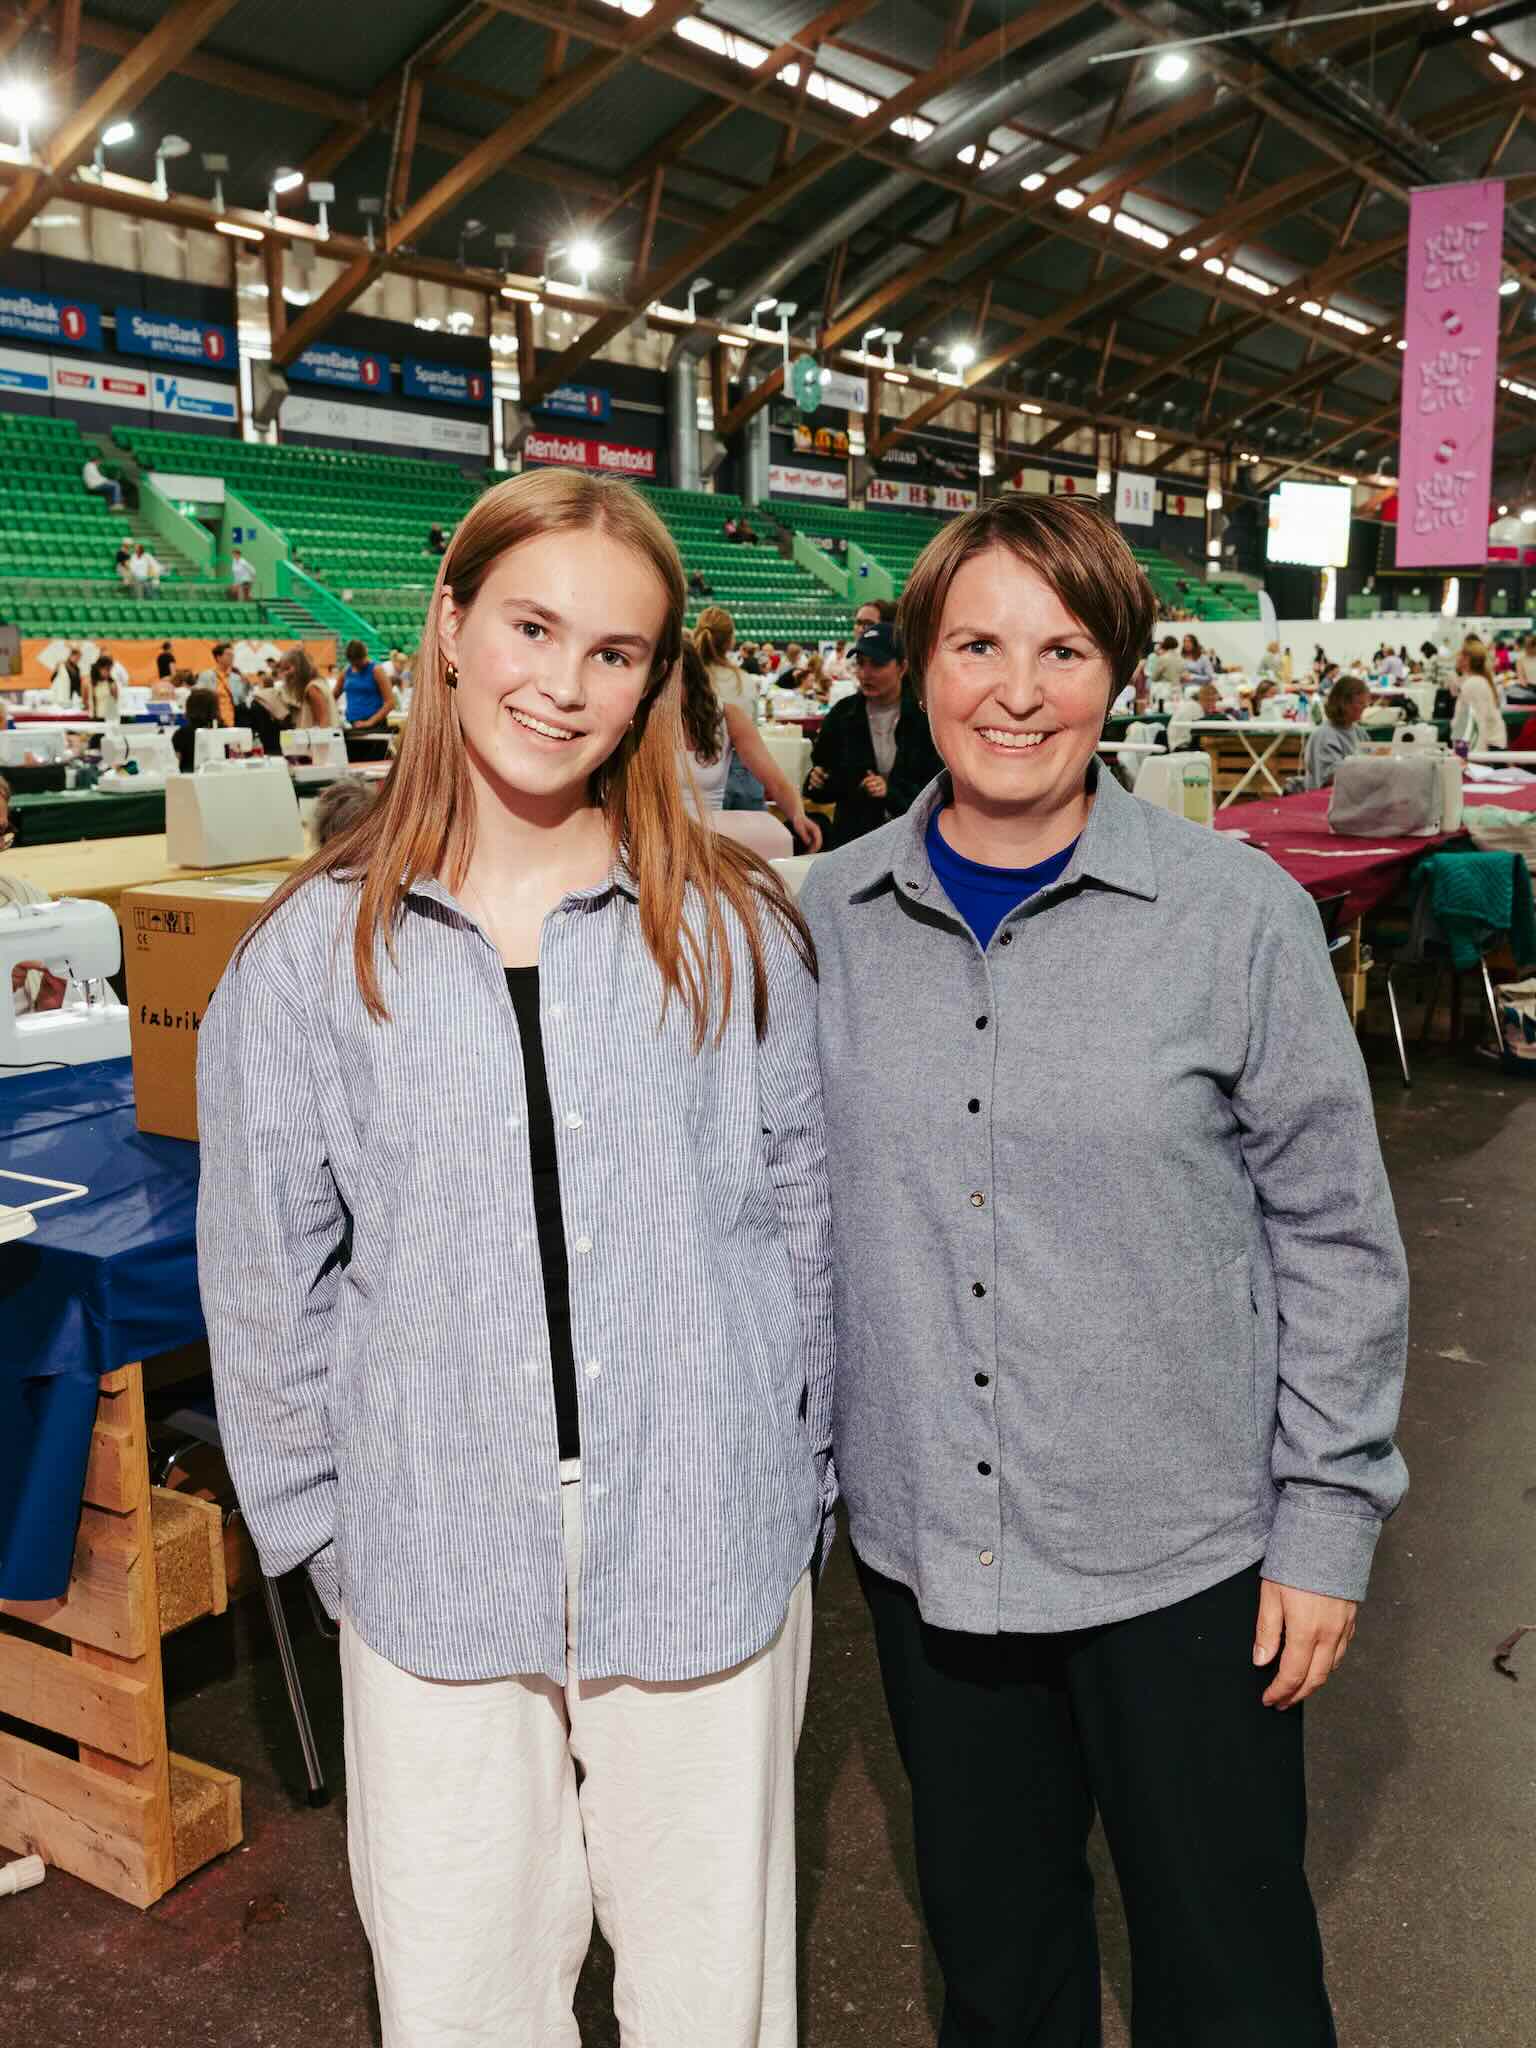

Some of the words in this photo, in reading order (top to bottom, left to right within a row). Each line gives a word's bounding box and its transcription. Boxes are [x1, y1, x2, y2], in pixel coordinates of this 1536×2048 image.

[525, 434, 585, 462] Rentokil
[598, 444, 653, 470] Rentokil
[137, 933, 149, 945] CE
